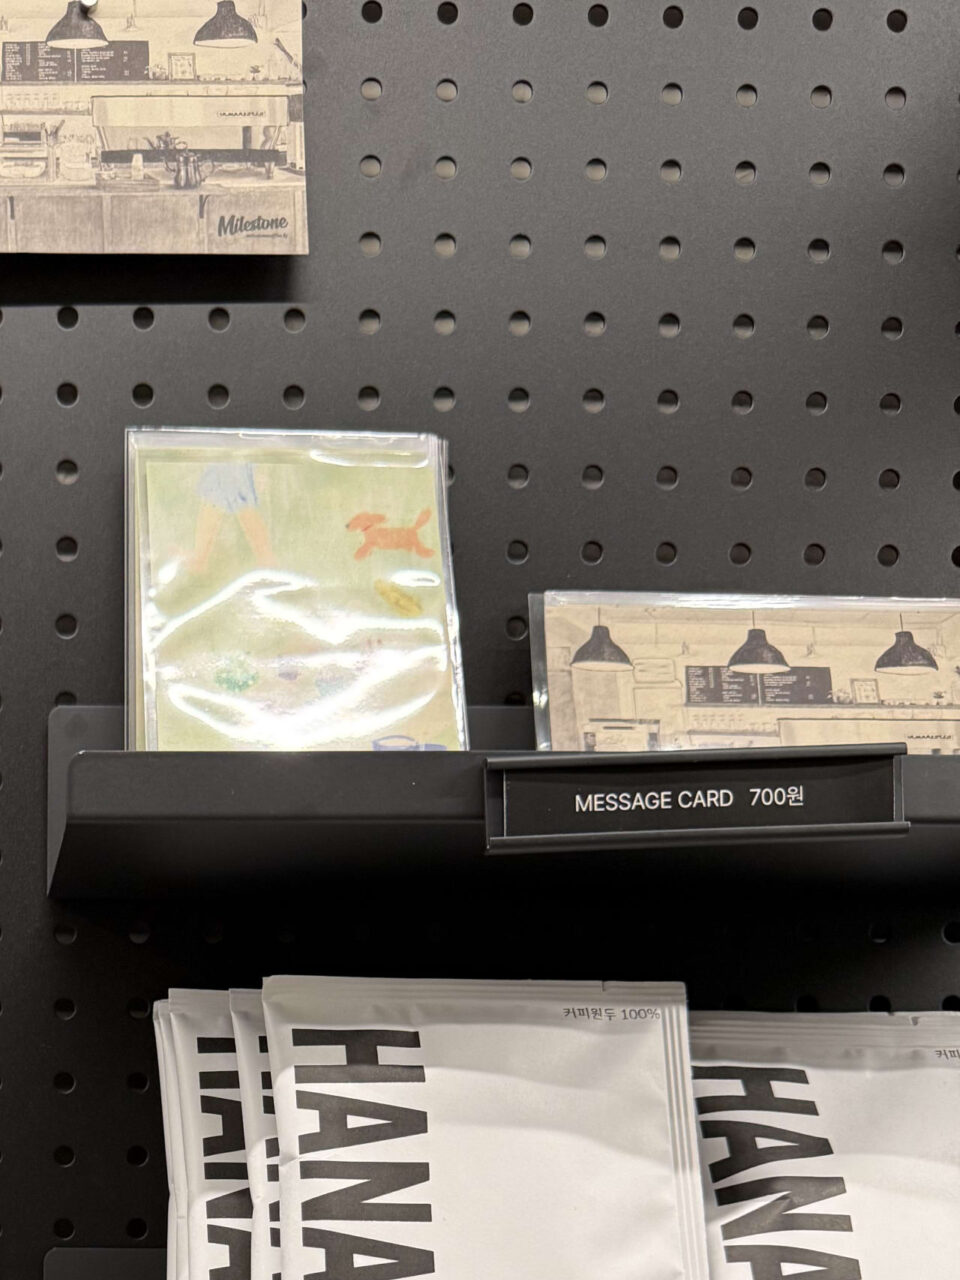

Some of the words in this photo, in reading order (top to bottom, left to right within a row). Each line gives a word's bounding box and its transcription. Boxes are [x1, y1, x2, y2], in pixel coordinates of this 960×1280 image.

[218, 215, 289, 237] Milestone
[575, 790, 672, 812] MESSAGE
[678, 789, 734, 808] CARD
[749, 785, 804, 807] 700원
[562, 1007, 617, 1021] 커피원두
[621, 1008, 661, 1021] 100%
